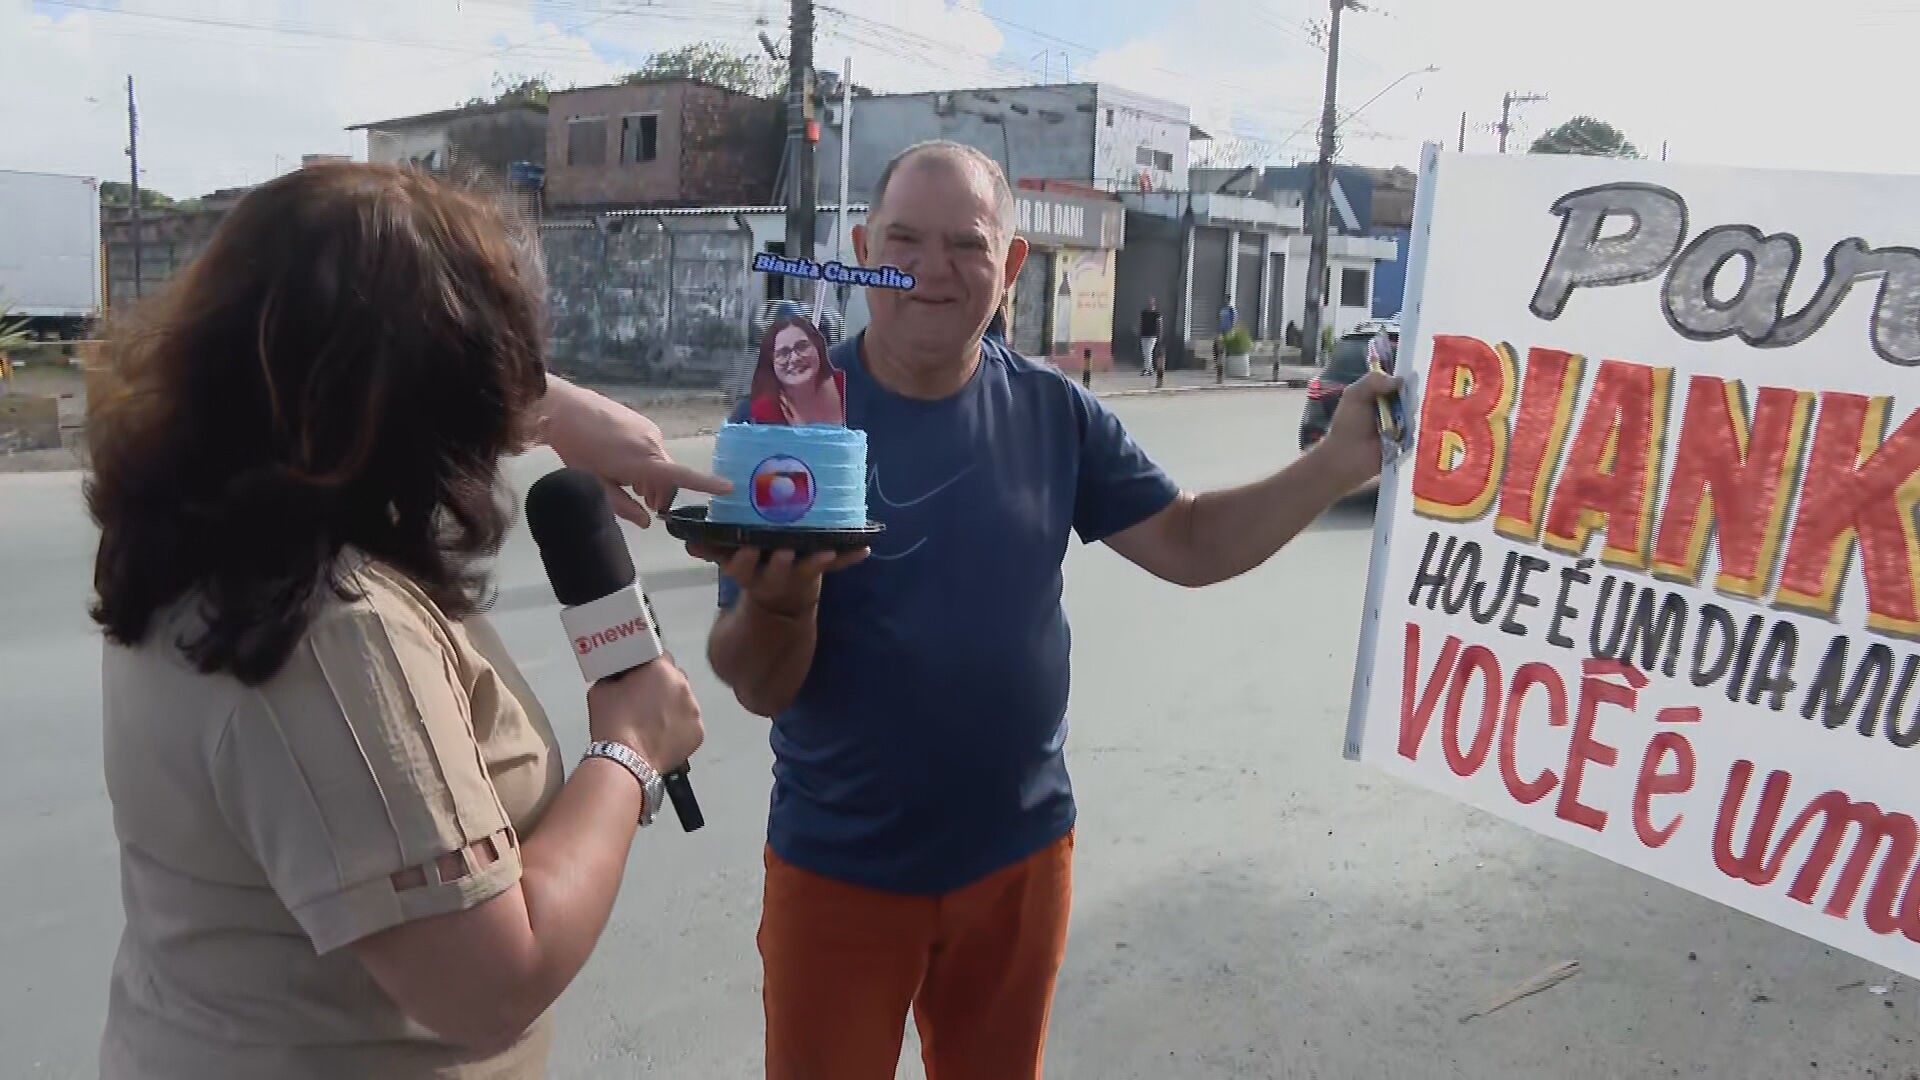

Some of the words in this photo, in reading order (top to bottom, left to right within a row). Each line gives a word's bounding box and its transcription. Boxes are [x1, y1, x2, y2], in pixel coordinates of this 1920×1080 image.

[753, 253, 822, 280] Bianka
[824, 262, 916, 289] Carvalho
[1034, 200, 1051, 234] DA
[1053, 203, 1084, 238] DANI
[1412, 334, 1920, 642] BIANK
[592, 617, 648, 648] news
[1408, 532, 1549, 636] HOJE
[1546, 558, 1595, 649] É
[1590, 575, 1691, 678] UM
[1691, 602, 1798, 711] DIA
[1397, 621, 1650, 832] VOCÊ
[1711, 759, 1920, 944] um
